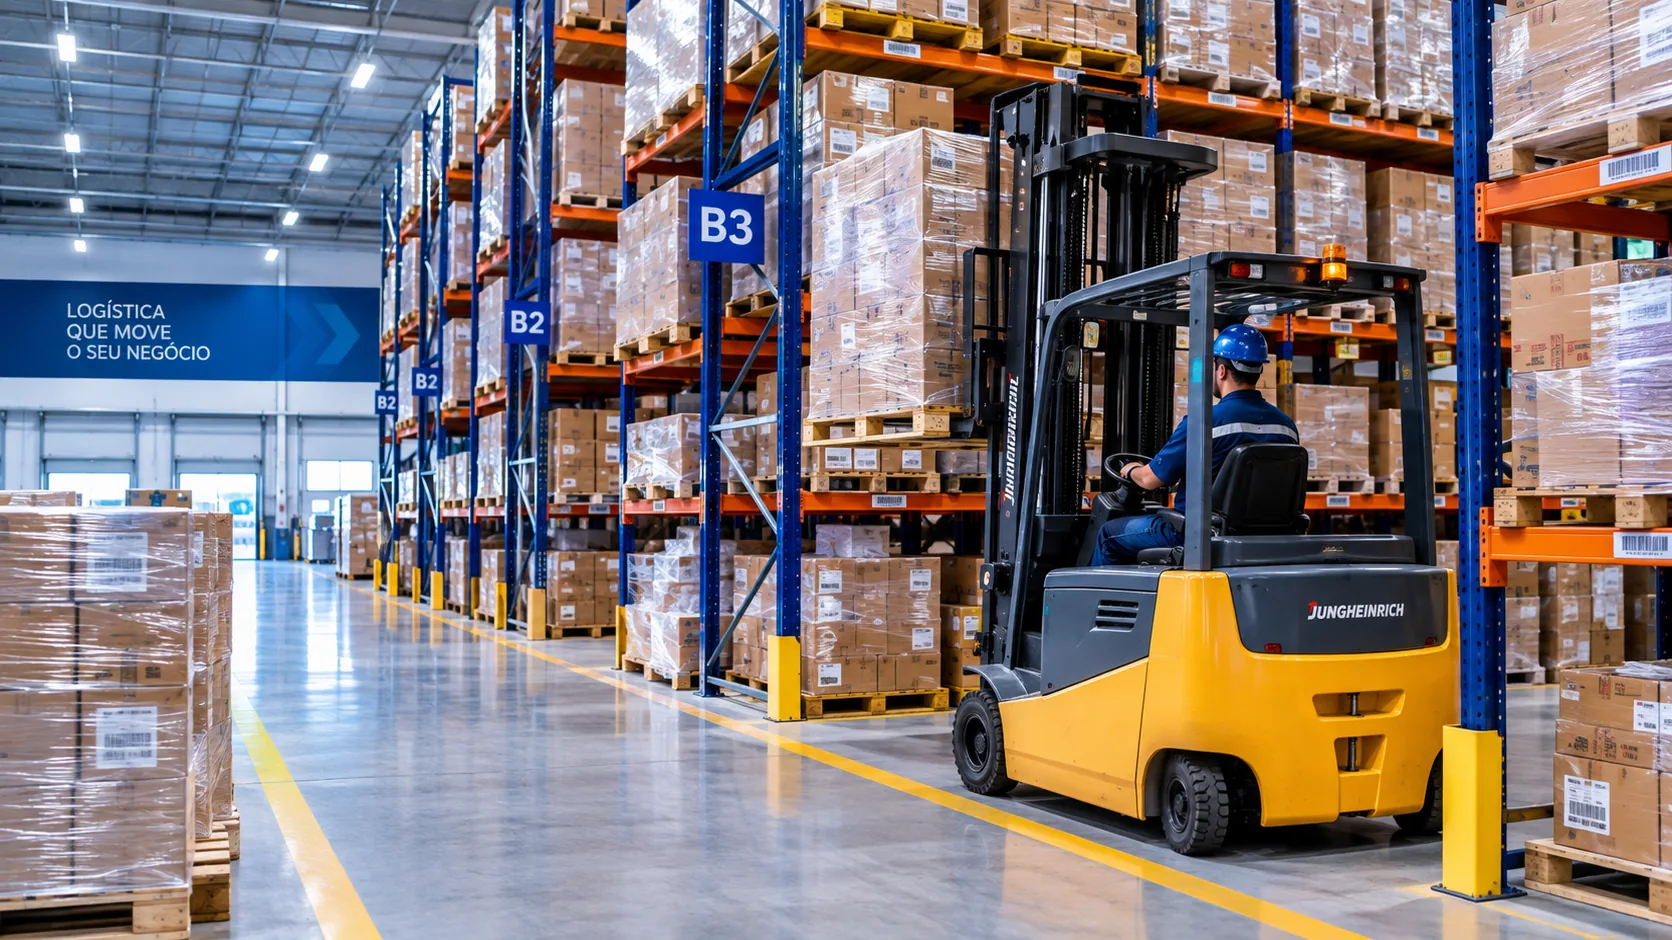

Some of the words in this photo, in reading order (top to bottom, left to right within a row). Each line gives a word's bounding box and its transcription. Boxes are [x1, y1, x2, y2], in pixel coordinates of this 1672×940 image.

[701, 206, 753, 245] B3
[67, 299, 165, 319] LOGÍSTICA
[67, 323, 109, 341] QUE
[115, 324, 172, 340] MOVE
[510, 311, 545, 334] B2
[67, 344, 82, 359] O
[87, 345, 121, 360] SEU
[126, 342, 210, 361] NEGÓCIO
[415, 373, 438, 390] B2
[377, 395, 397, 410] B2
[1307, 600, 1405, 620] JUNGHEINRICH
